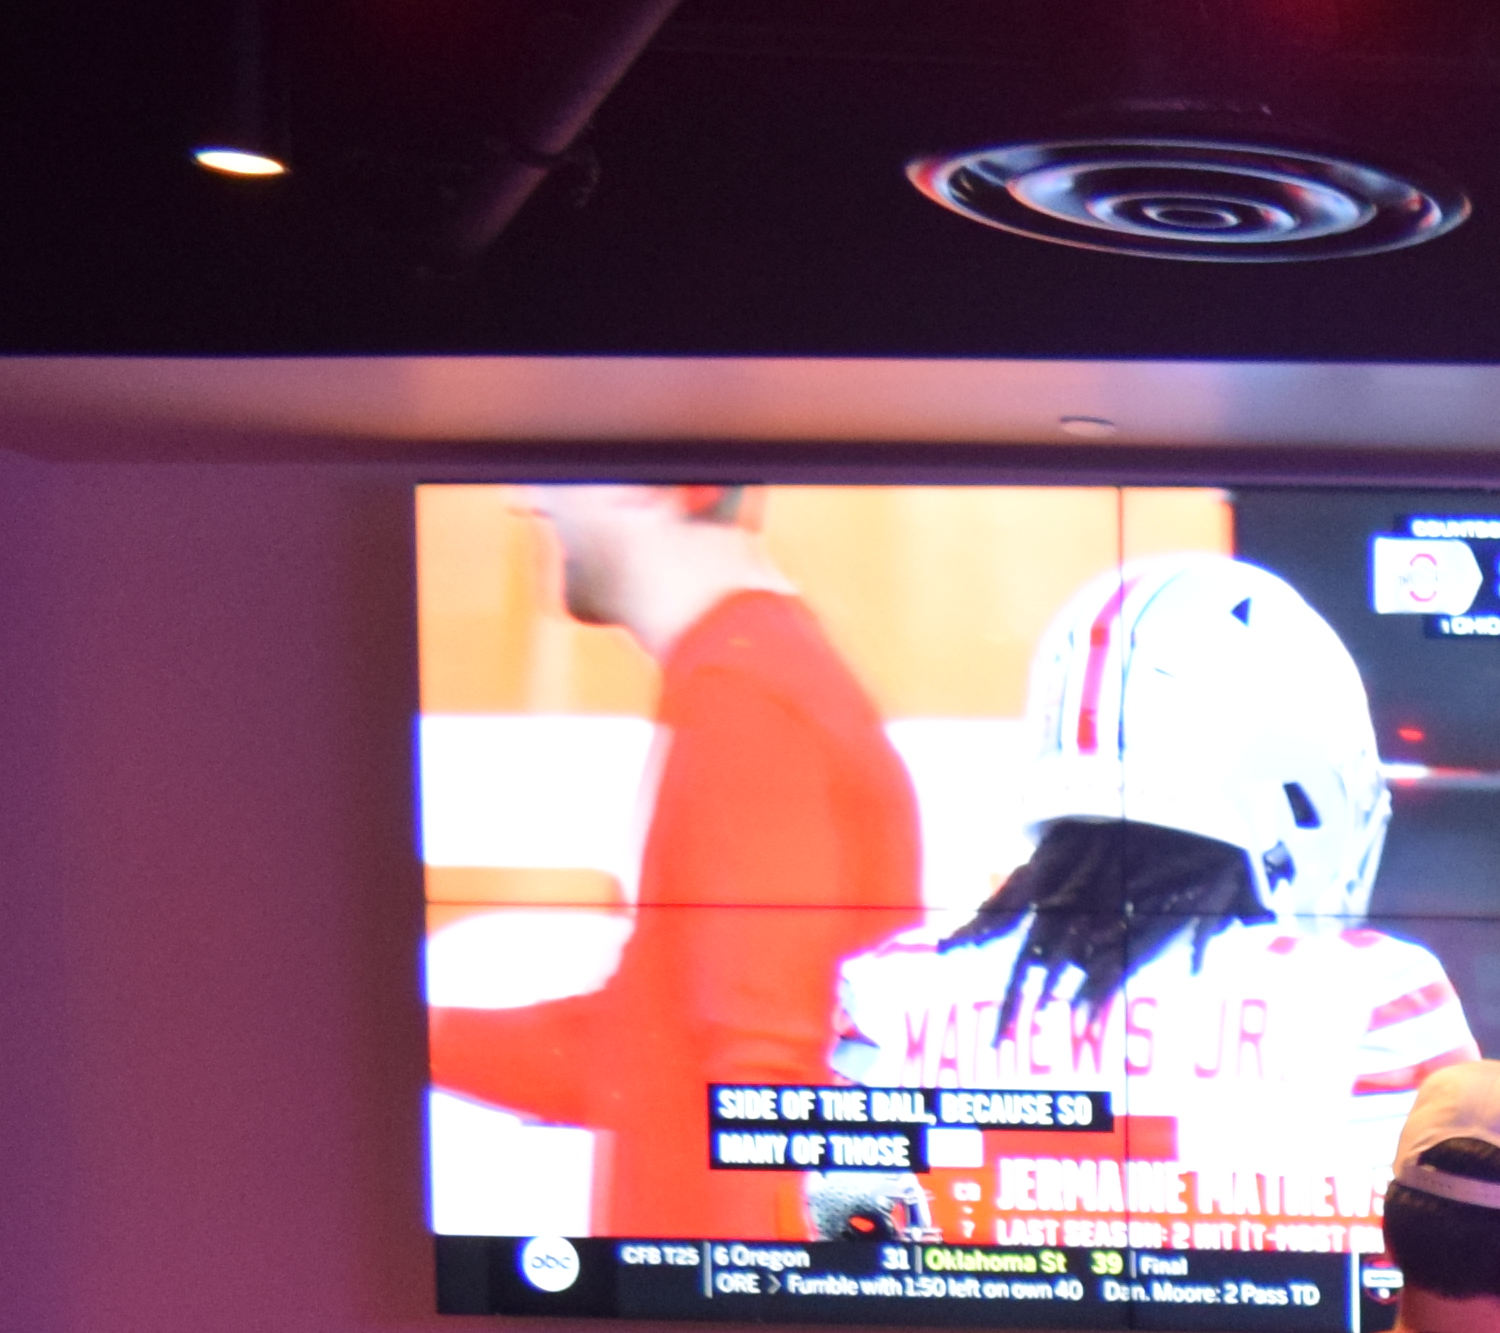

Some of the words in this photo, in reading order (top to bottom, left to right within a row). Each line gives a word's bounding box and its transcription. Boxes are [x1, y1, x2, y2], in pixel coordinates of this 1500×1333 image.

[903, 997, 1157, 1088] MATHEWS
[718, 1090, 778, 1120] SIDE
[781, 1091, 815, 1121] OF
[820, 1092, 867, 1122] THE
[870, 1092, 937, 1126] BALL,
[940, 1094, 1053, 1125] BECAUSE
[1057, 1096, 1093, 1126] SO
[718, 1132, 788, 1165] MANY
[791, 1134, 825, 1165] OF
[829, 1136, 910, 1168] THOSE
[998, 1158, 1189, 1213] JERMAINE
[998, 1219, 1060, 1247] LAST
[1172, 1223, 1190, 1249] 2
[531, 1252, 573, 1270] abc
[620, 1246, 661, 1265] CFB
[664, 1246, 700, 1266] T25
[714, 1247, 729, 1266] 6
[731, 1247, 810, 1271] Oregon
[882, 1248, 910, 1270] 31
[925, 1249, 1037, 1273] Oklahoma
[1039, 1250, 1067, 1273] St
[1091, 1252, 1123, 1275] 39
[1141, 1254, 1187, 1275] Final
[715, 1274, 760, 1294] ORE
[786, 1274, 858, 1296] Fumble
[861, 1277, 901, 1297] with
[905, 1277, 946, 1298] 1:50
[948, 1278, 981, 1299] left
[983, 1284, 1010, 1299] on
[1012, 1284, 1053, 1301] own
[1054, 1280, 1084, 1301] 40
[1104, 1281, 1150, 1302] Dan.
[1152, 1282, 1221, 1304] Moore:
[1223, 1283, 1239, 1304] 2
[1241, 1283, 1287, 1305] Pass
[1288, 1285, 1320, 1306] TD
